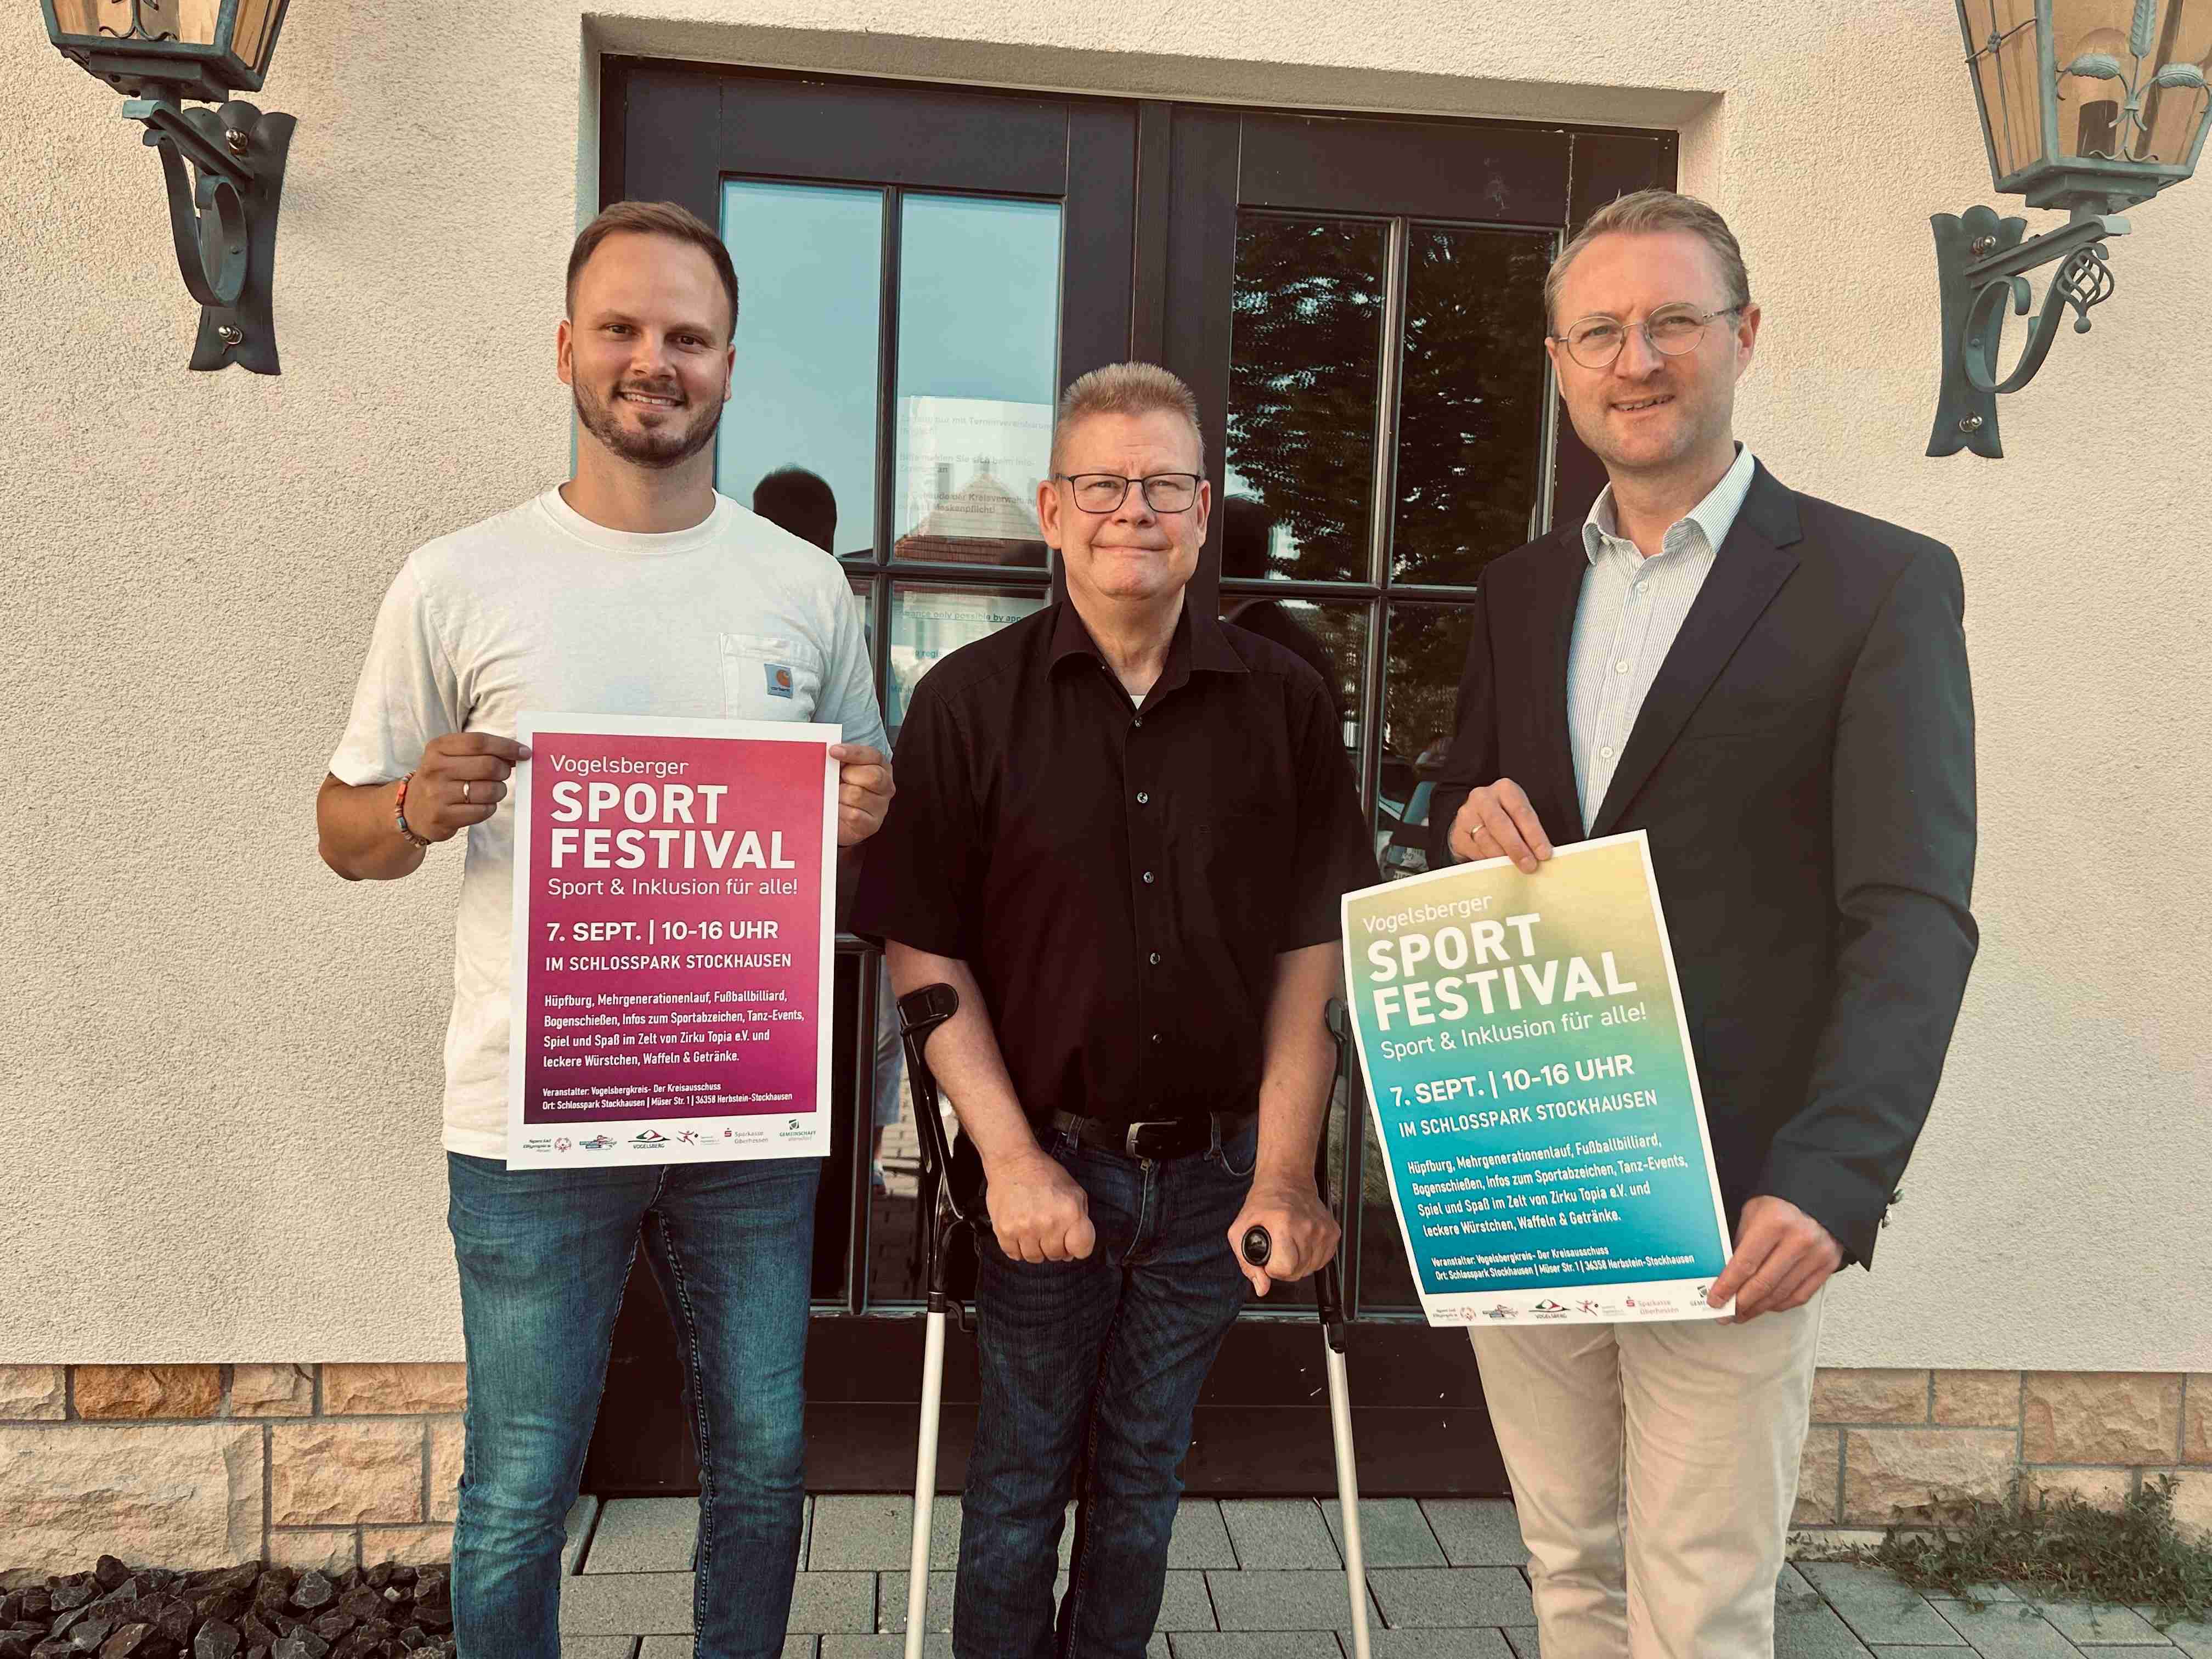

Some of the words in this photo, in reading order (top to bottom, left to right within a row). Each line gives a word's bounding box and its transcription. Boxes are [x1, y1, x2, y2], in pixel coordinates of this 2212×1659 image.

[993, 614, 1003, 622] by
[550, 754, 689, 778] Vogelsberger
[550, 781, 728, 824] SPORT
[551, 828, 795, 869] FESTIVAL
[548, 878, 604, 899] Sport
[610, 878, 625, 895] &
[633, 878, 720, 895] Inklusion
[726, 878, 754, 895] für
[759, 878, 797, 894] alle!
[1362, 895, 1493, 933] Vogelsberger
[546, 923, 565, 941] 7.
[573, 922, 641, 941] SEPT.
[662, 921, 723, 940] 10-16
[730, 921, 778, 939] UHR
[1368, 912, 1541, 982] SPORT
[546, 957, 563, 971] IM
[569, 955, 681, 971] SCHLOSSPARK
[686, 953, 791, 969] STOCKHAUSEN
[545, 995, 595, 1009] Hüpfburg,
[597, 991, 712, 1007] Mehrgenerationenlauf,
[714, 989, 787, 1002] Fußballbilliard,
[1372, 950, 1638, 1031] FESTIVAL
[544, 1014, 620, 1030] Bogenschießen,
[622, 1013, 646, 1025] Infos
[648, 1015, 668, 1024] zum
[670, 1011, 746, 1026] Sportabzeichen,
[747, 1009, 804, 1022] Tanz-Events,
[1380, 1036, 1436, 1061] Sport
[1440, 1031, 1457, 1050] &
[1461, 1019, 1556, 1047] Inklusion
[1561, 1012, 1593, 1032] für
[1600, 1001, 1646, 1026] alle!
[544, 1035, 570, 1050] Spiel
[573, 1035, 592, 1047] und
[595, 1034, 620, 1048] Spaß
[623, 1034, 635, 1045] im
[638, 1032, 657, 1045] Zelt
[659, 1035, 677, 1043] von
[680, 1031, 705, 1043] Zirku
[707, 1030, 732, 1045] Topia
[735, 1029, 749, 1041] e.V.
[752, 1029, 770, 1041] und
[544, 1056, 582, 1067] leckere
[584, 1054, 641, 1066] Würstchen,
[643, 1052, 680, 1064] Waffeln
[682, 1051, 691, 1063] &
[693, 1050, 740, 1063] Getränke.
[653, 1084, 666, 1093] Der
[667, 1082, 721, 1092] Kreisausschuss
[1389, 1086, 1410, 1107] 7.
[1414, 1076, 1485, 1104] SEPT.
[1502, 1063, 1570, 1092] 10-16
[1575, 1054, 1634, 1081] UHR
[557, 1099, 600, 1111] Schlosspark
[601, 1098, 645, 1108] Stockhausen
[651, 1097, 672, 1106] Müser
[686, 1096, 690, 1104] 1
[695, 1094, 716, 1104] 36358
[717, 1092, 793, 1103] Herbstein-Stockhausen
[1398, 1121, 1417, 1138] IM
[1420, 1107, 1532, 1135] SCHLOSSPARK
[1536, 1089, 1657, 1121] STOCKHAUSEN
[1407, 1159, 1455, 1176] Hüpfburg,
[1456, 1143, 1574, 1169] Mehrgenerationenlauf,
[1575, 1132, 1662, 1155] Fußballbilliard,
[1412, 1177, 1486, 1197] Bogenschießen,
[1486, 1174, 1510, 1188] Infos
[1511, 1173, 1533, 1186] zum
[1534, 1164, 1617, 1186] Sportabzeichen,
[1617, 1154, 1689, 1173] Tanz-Events,
[1417, 1202, 1443, 1218] Spiel
[1444, 1200, 1464, 1214] und
[1464, 1197, 1490, 1215] Spaß
[1491, 1197, 1506, 1210] im
[1506, 1194, 1528, 1208] Zelt
[1528, 1195, 1548, 1206] von
[1549, 1189, 1577, 1204] Zirku
[1578, 1186, 1607, 1203] Topia
[1610, 1183, 1627, 1198] e.V.
[1629, 1180, 1651, 1196] und
[1423, 1223, 1460, 1237] leckere
[1460, 1219, 1517, 1234] Würstchen,
[1516, 1214, 1557, 1229] Waffeln
[1559, 1212, 1568, 1226] &
[1569, 1208, 1621, 1224] Getränke.
